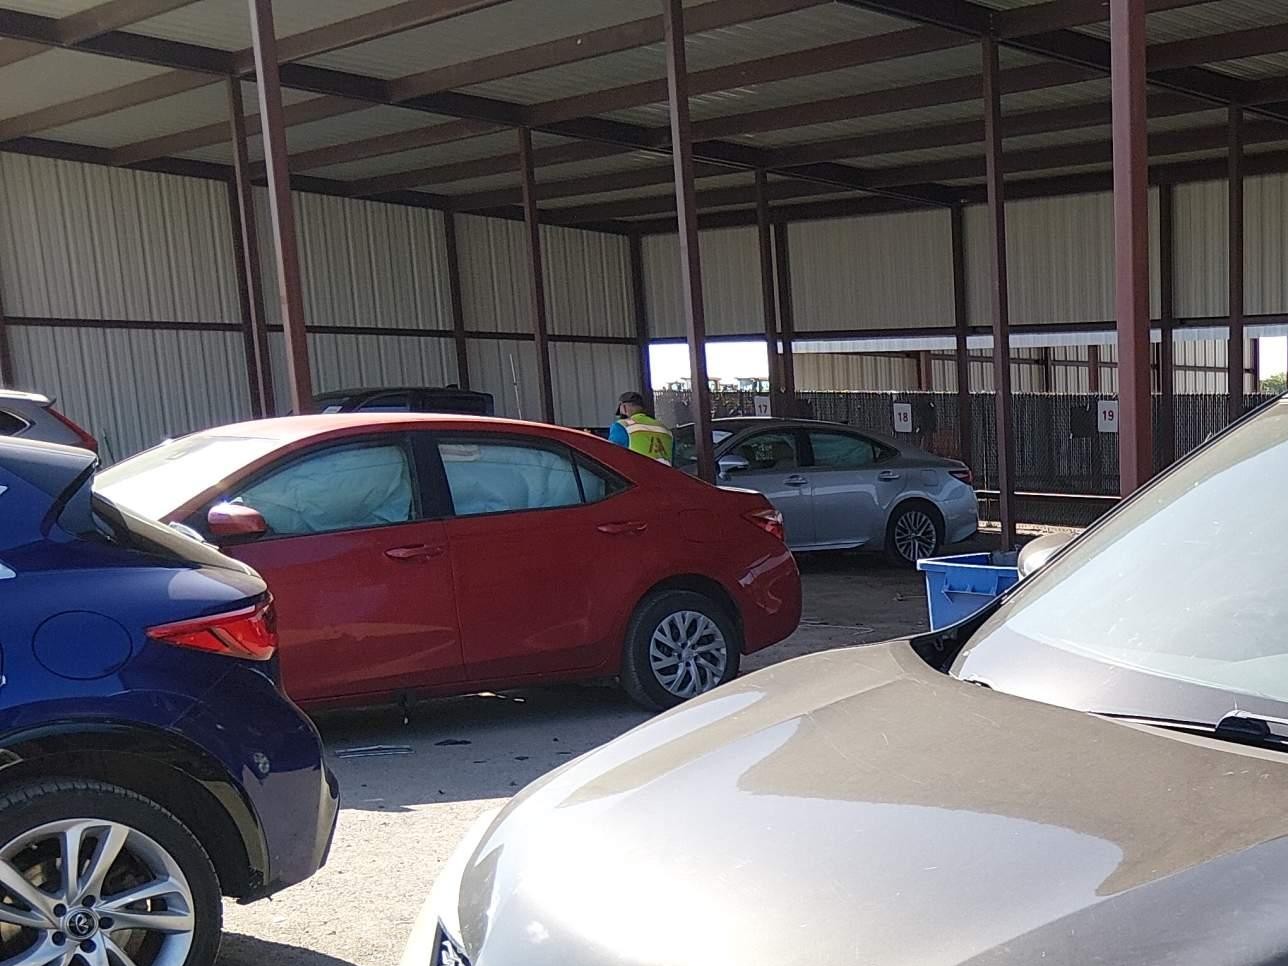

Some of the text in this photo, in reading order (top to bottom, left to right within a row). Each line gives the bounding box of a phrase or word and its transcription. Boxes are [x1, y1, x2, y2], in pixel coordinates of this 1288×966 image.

[758, 404, 768, 414] 17
[897, 412, 909, 423] 18
[1103, 410, 1114, 421] 19
